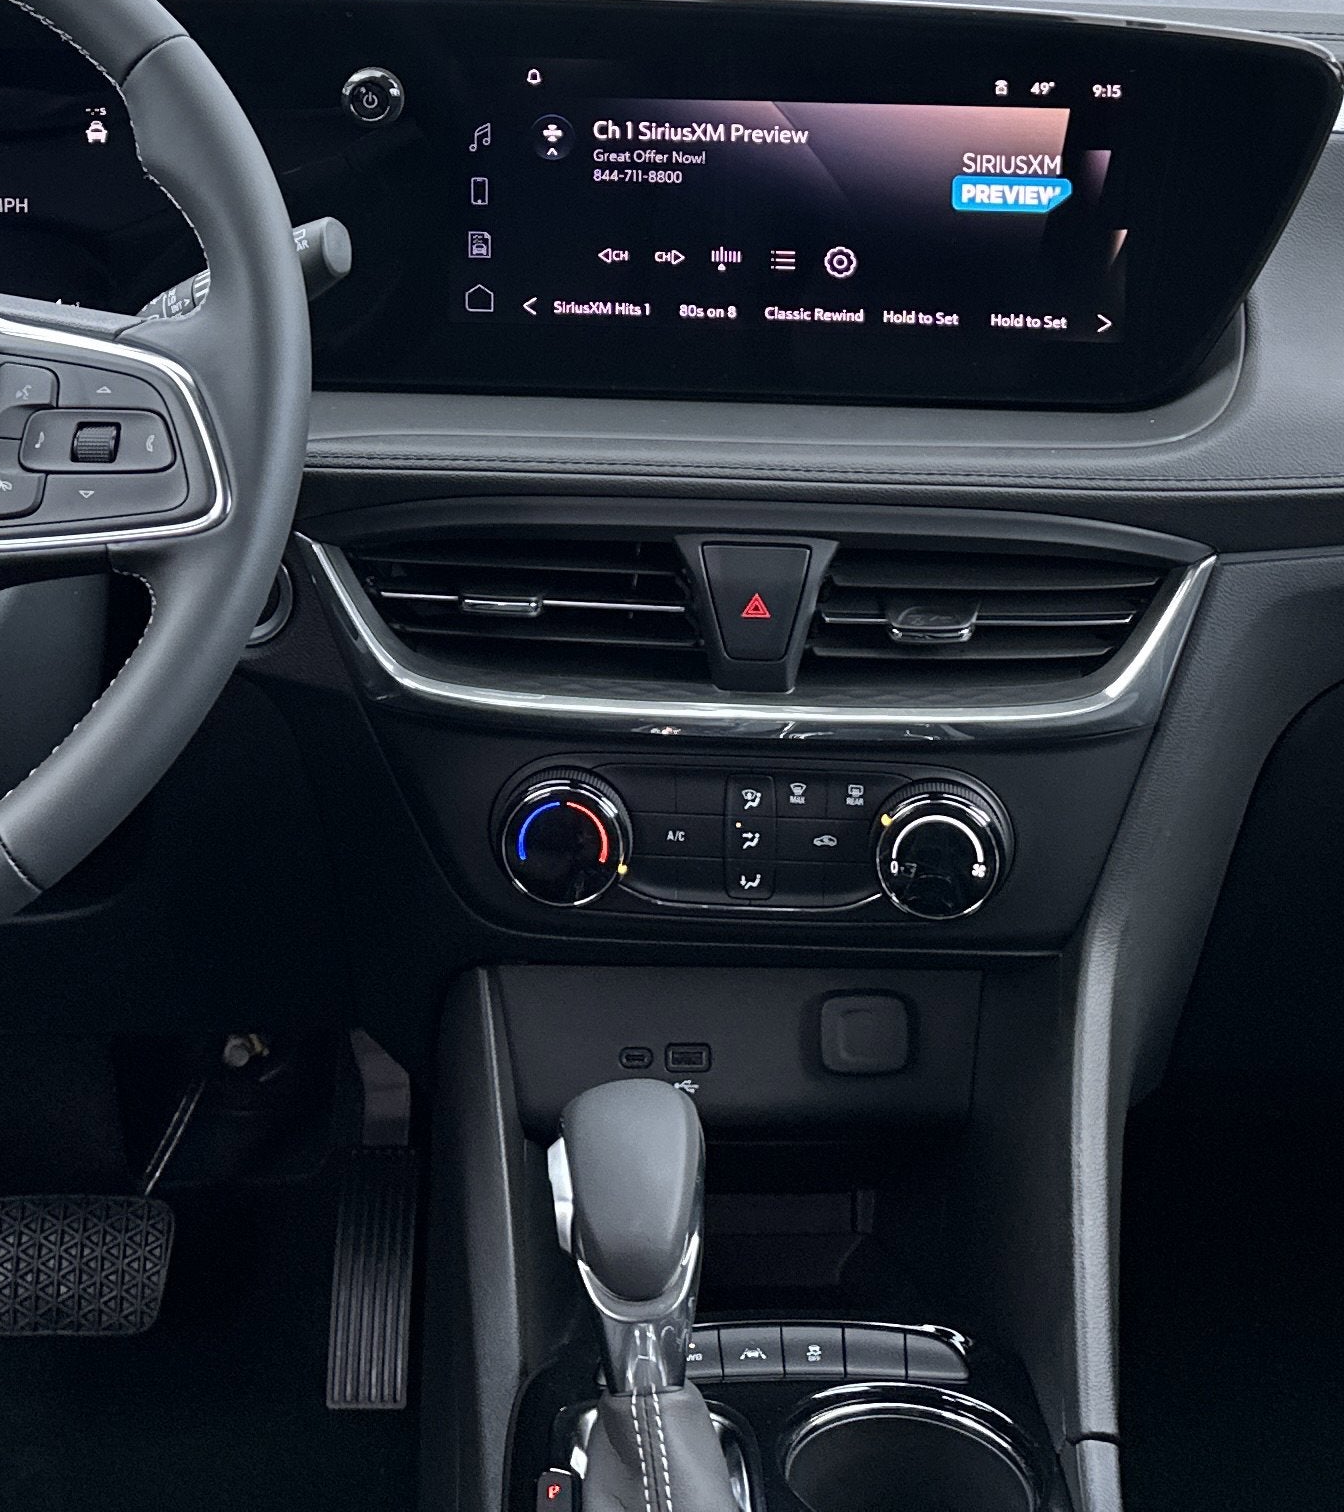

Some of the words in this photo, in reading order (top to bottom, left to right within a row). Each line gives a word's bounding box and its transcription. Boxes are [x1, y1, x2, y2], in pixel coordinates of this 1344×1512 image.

[1030, 81, 1055, 95] 49°
[1092, 84, 1122, 98] 9:15
[593, 120, 620, 140] Ch
[625, 122, 632, 140] 1
[638, 121, 724, 143] SiriusXM
[730, 124, 809, 144] Preview
[593, 149, 631, 163] Great
[633, 150, 668, 164] Offer
[672, 151, 706, 165] Now!
[962, 152, 1061, 175] SIRIUSXM
[592, 169, 683, 184] 844-711-8800
[961, 183, 1061, 205] PREVIEW
[612, 250, 630, 262] CH
[654, 251, 671, 262] CH
[553, 300, 611, 315] SiriusXM
[614, 301, 642, 316] Hits
[644, 303, 651, 316] 1
[679, 304, 704, 318] 80s
[706, 306, 724, 318] on
[727, 305, 737, 318] 8
[764, 306, 811, 321] Classic
[814, 308, 864, 322] Rewind
[883, 310, 915, 324] Hold
[917, 312, 933, 324] to
[935, 312, 959, 326] Set
[990, 314, 1023, 327] Hold
[1025, 315, 1041, 328] to
[1043, 316, 1067, 329] Set
[846, 796, 864, 806] REAR
[666, 829, 686, 843] A/C
[890, 861, 898, 873] 0
[548, 1485, 560, 1499] P
